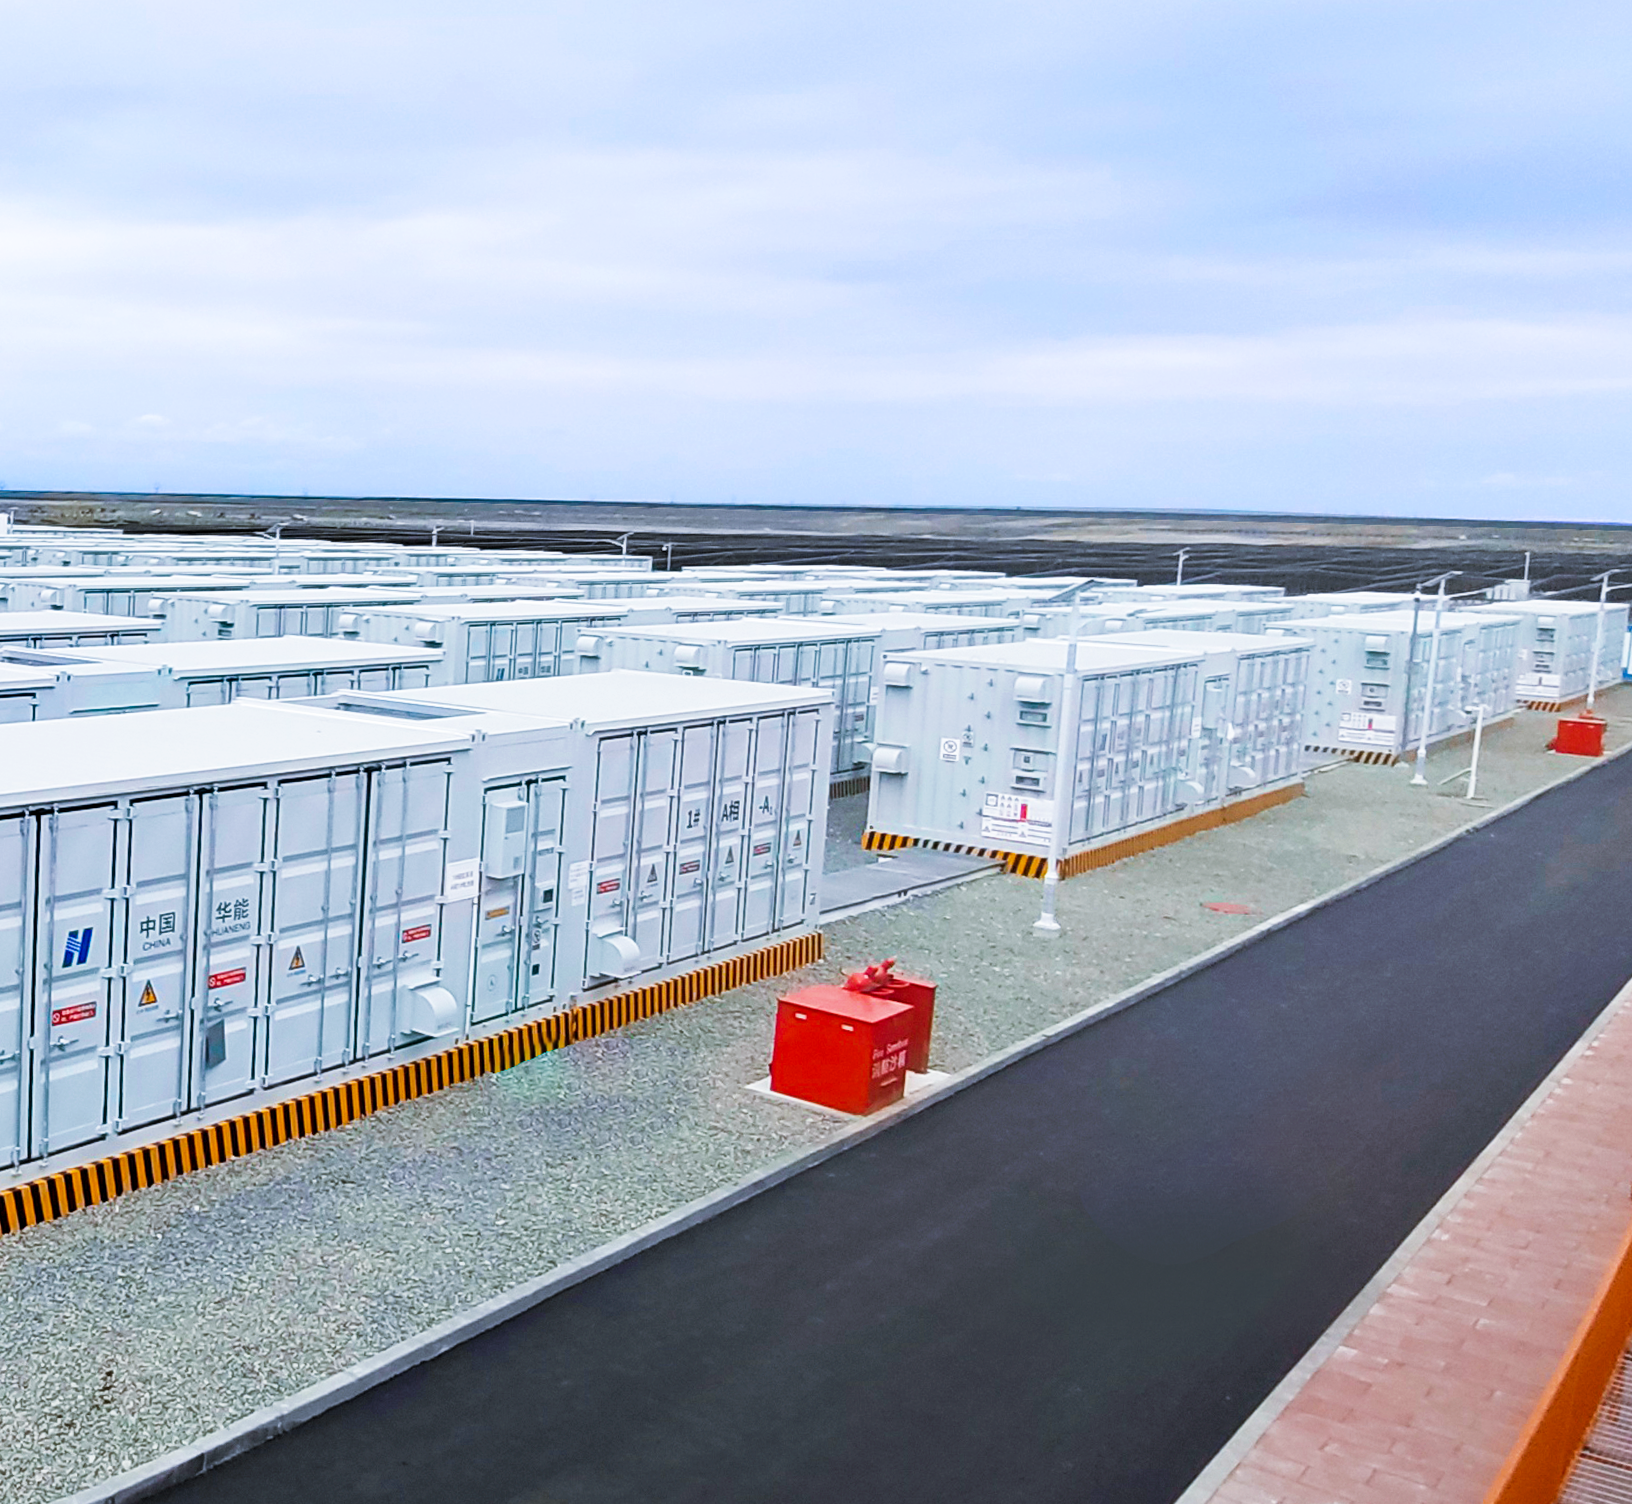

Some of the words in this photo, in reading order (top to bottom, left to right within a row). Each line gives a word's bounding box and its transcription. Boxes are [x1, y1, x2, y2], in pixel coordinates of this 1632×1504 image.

[686, 808, 701, 829] 1#
[140, 911, 175, 938] 中国
[215, 898, 250, 923] 华能
[143, 938, 171, 951] CHINA
